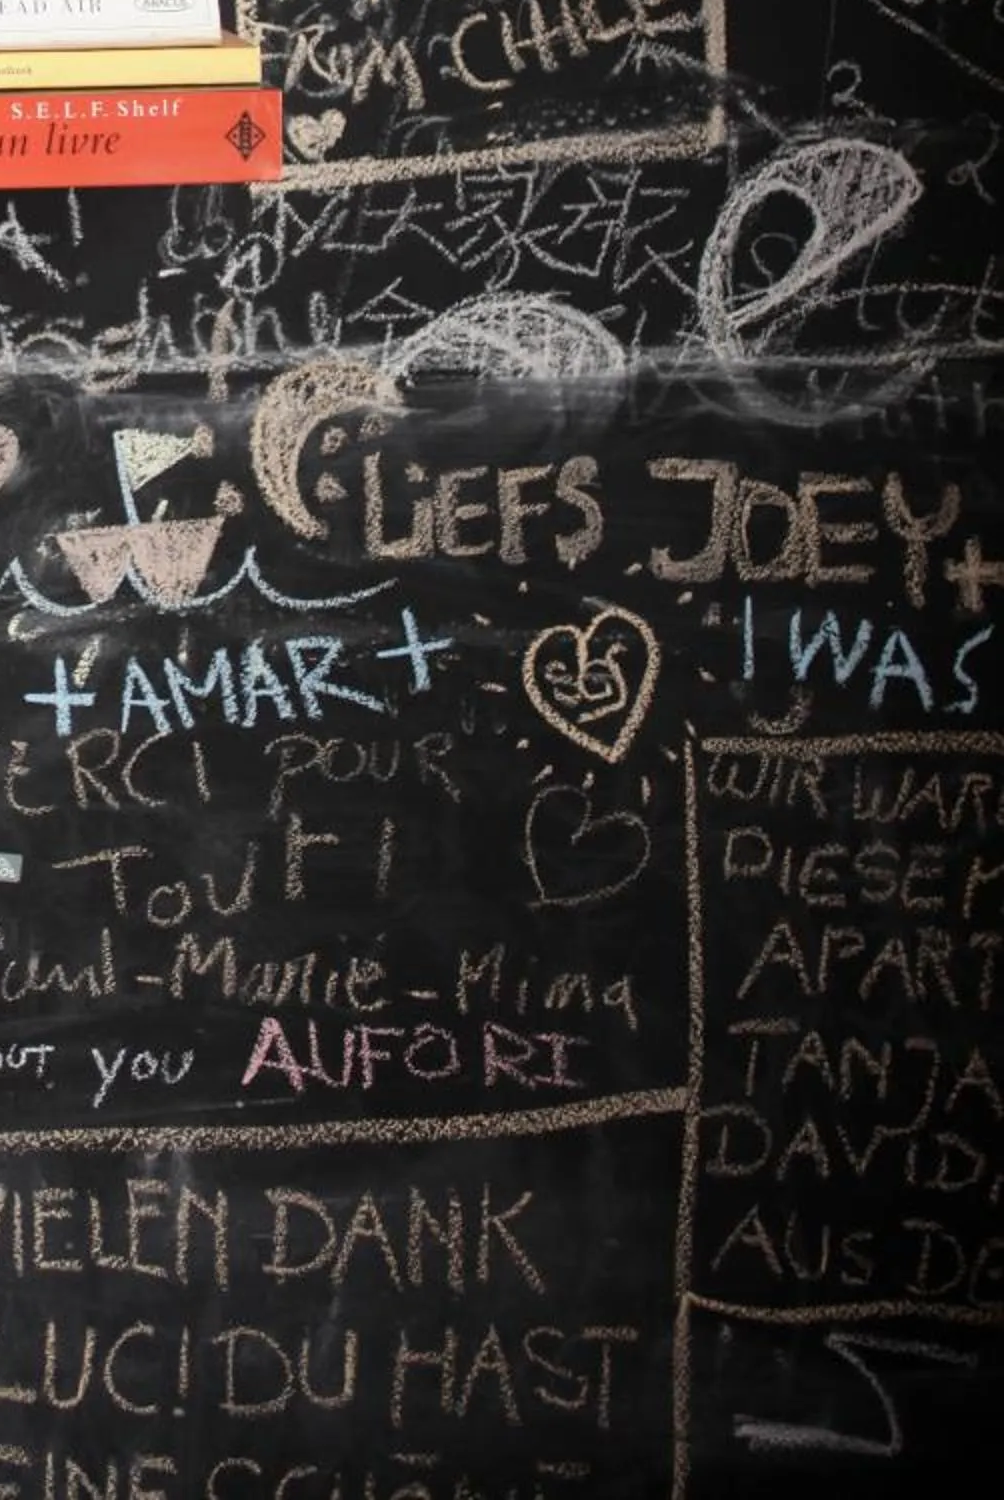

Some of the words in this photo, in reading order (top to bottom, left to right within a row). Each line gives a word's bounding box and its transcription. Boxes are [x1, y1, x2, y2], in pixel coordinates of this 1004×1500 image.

[46, 121, 121, 156] livre
[116, 98, 184, 118] Shelf
[646, 456, 962, 609] JOEY
[788, 605, 994, 716] WAS
[91, 1045, 195, 1109] you
[262, 1182, 545, 1295] DANK
[710, 1203, 875, 1286] AUS
[213, 1324, 359, 1417] DU
[388, 1322, 639, 1430] HAST
